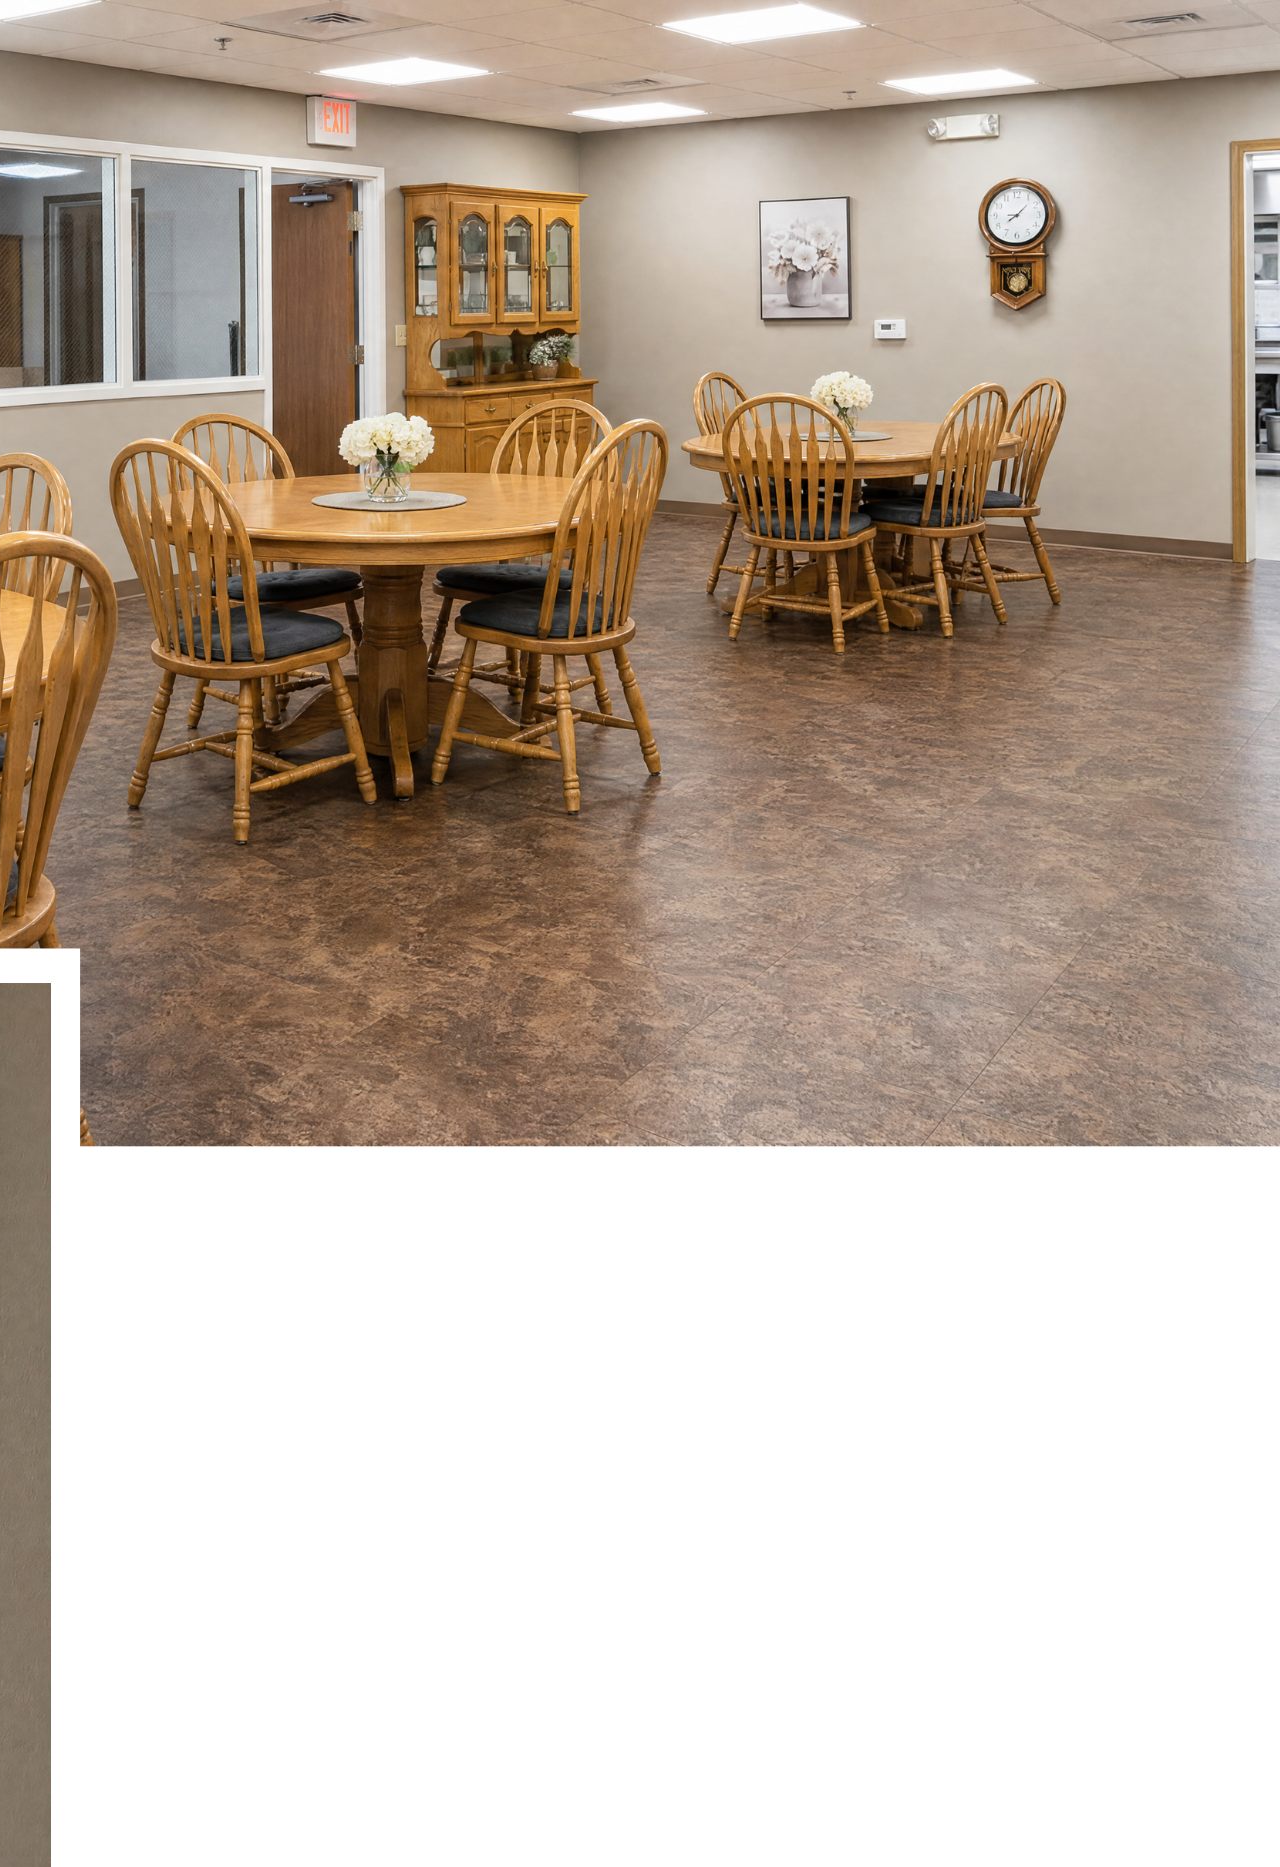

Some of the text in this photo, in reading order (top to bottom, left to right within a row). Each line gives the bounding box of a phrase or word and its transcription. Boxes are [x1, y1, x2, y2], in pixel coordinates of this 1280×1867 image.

[323, 101, 351, 134] EXIT
[1003, 194, 1010, 202] 11
[1013, 190, 1021, 199] 12
[995, 202, 1003, 210] 10
[1033, 201, 1039, 209] 2
[993, 212, 998, 220] 9
[1036, 211, 1041, 219] 3
[995, 222, 1001, 230] 8
[1032, 221, 1040, 229] 4
[1004, 228, 1010, 237] 7
[1014, 231, 1020, 239] 6
[1025, 228, 1031, 238] 5
